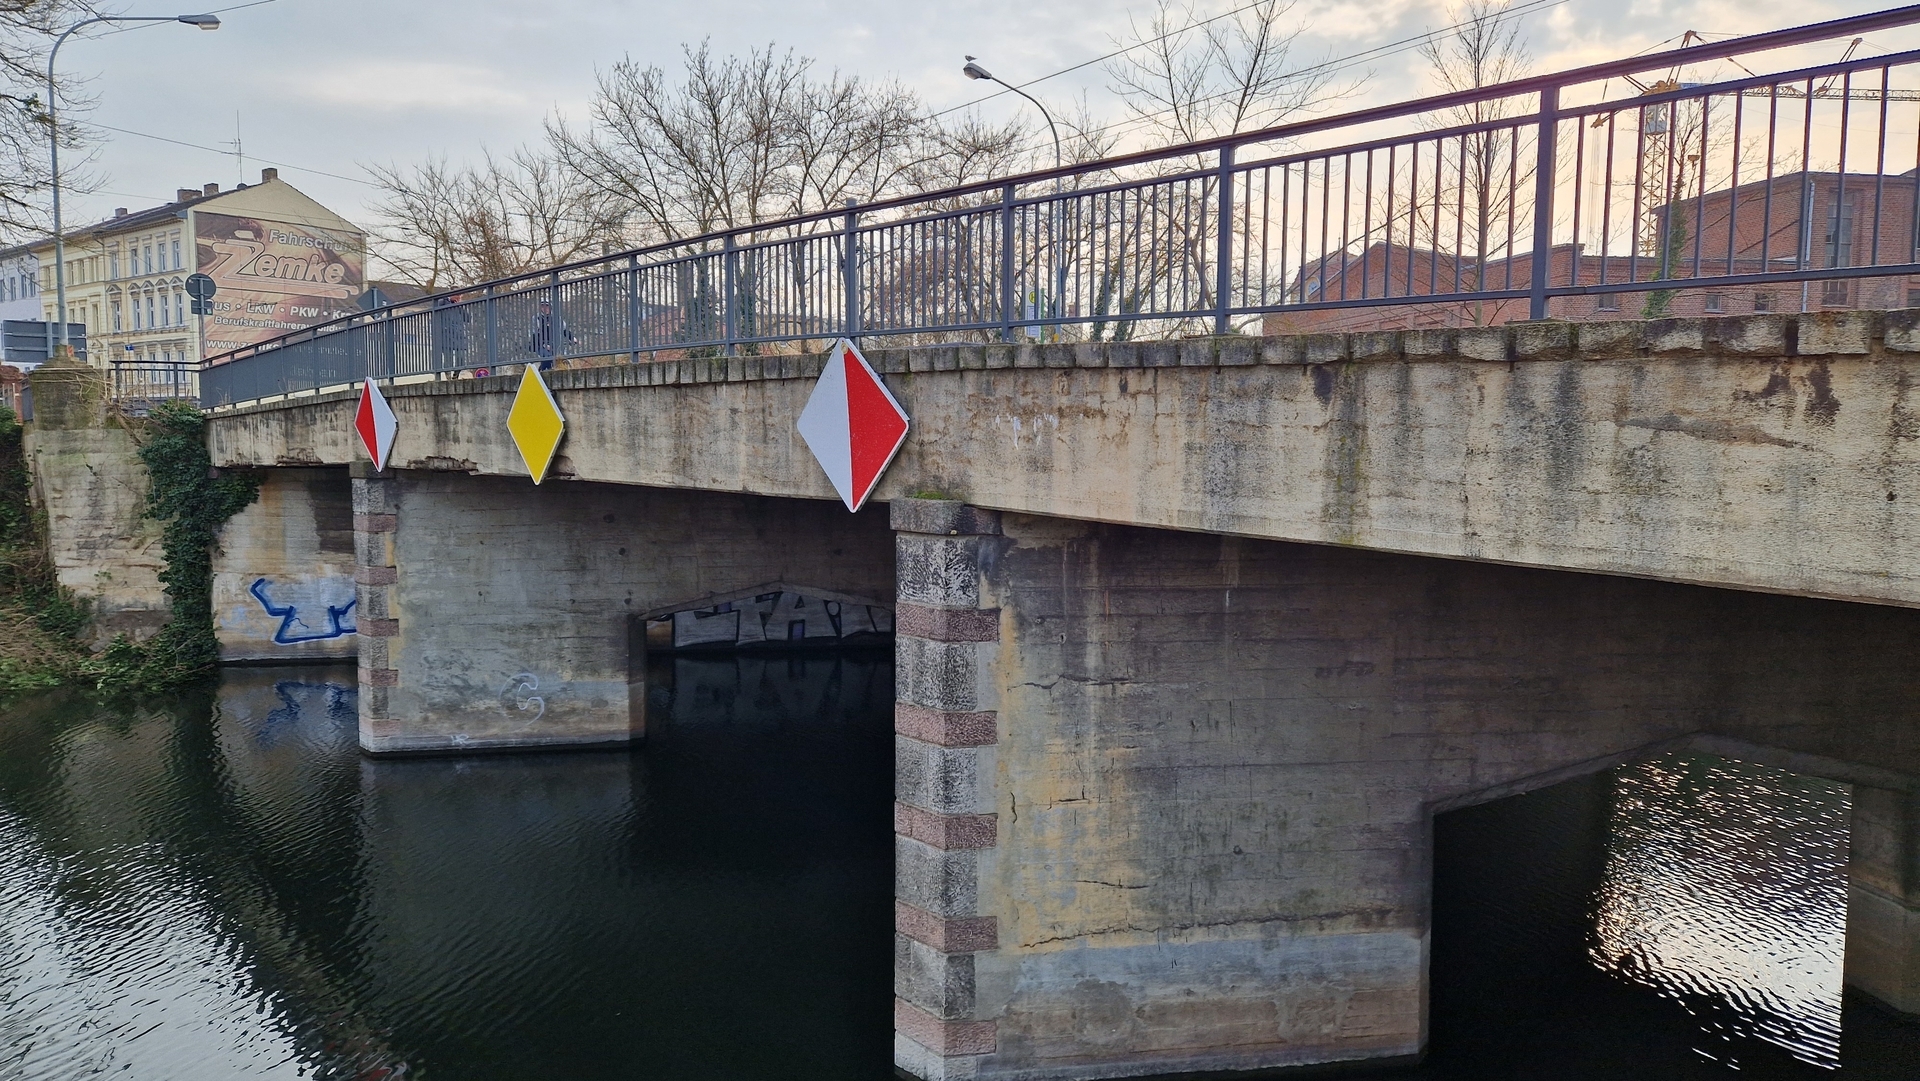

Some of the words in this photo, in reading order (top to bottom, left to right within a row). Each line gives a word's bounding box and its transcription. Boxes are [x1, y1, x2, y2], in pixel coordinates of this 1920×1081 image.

[269, 229, 354, 252] Fahrschu
[208, 239, 346, 289] Zemke
[213, 301, 231, 311] us
[247, 302, 276, 315] LKW
[289, 306, 319, 318] PKW
